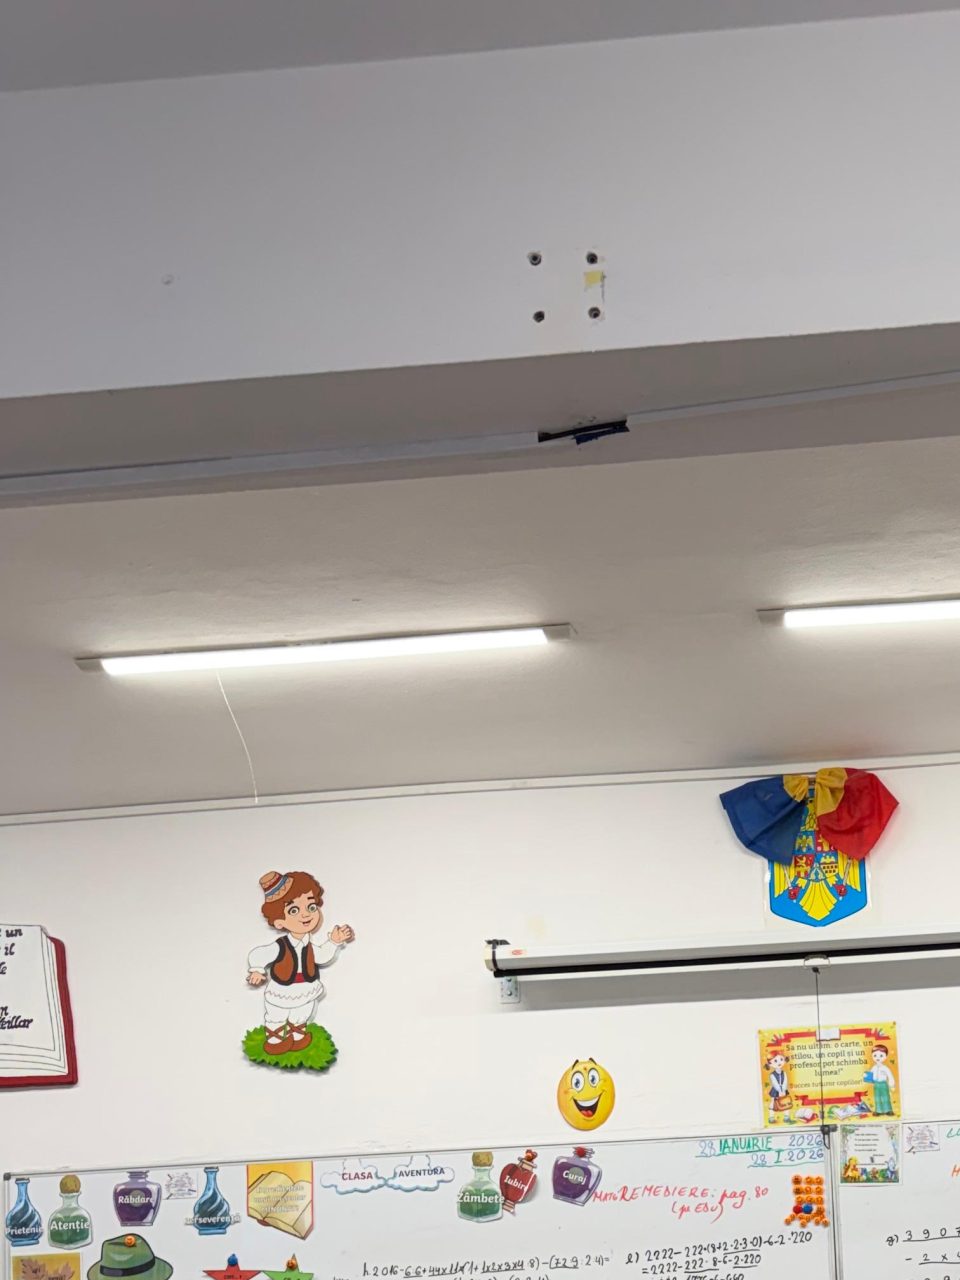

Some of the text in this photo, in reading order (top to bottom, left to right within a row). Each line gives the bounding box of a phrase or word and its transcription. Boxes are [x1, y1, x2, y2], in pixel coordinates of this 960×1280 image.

[789, 1134, 824, 1147] 2026
[342, 1171, 373, 1181] CLASA
[563, 1170, 587, 1185] Curaj
